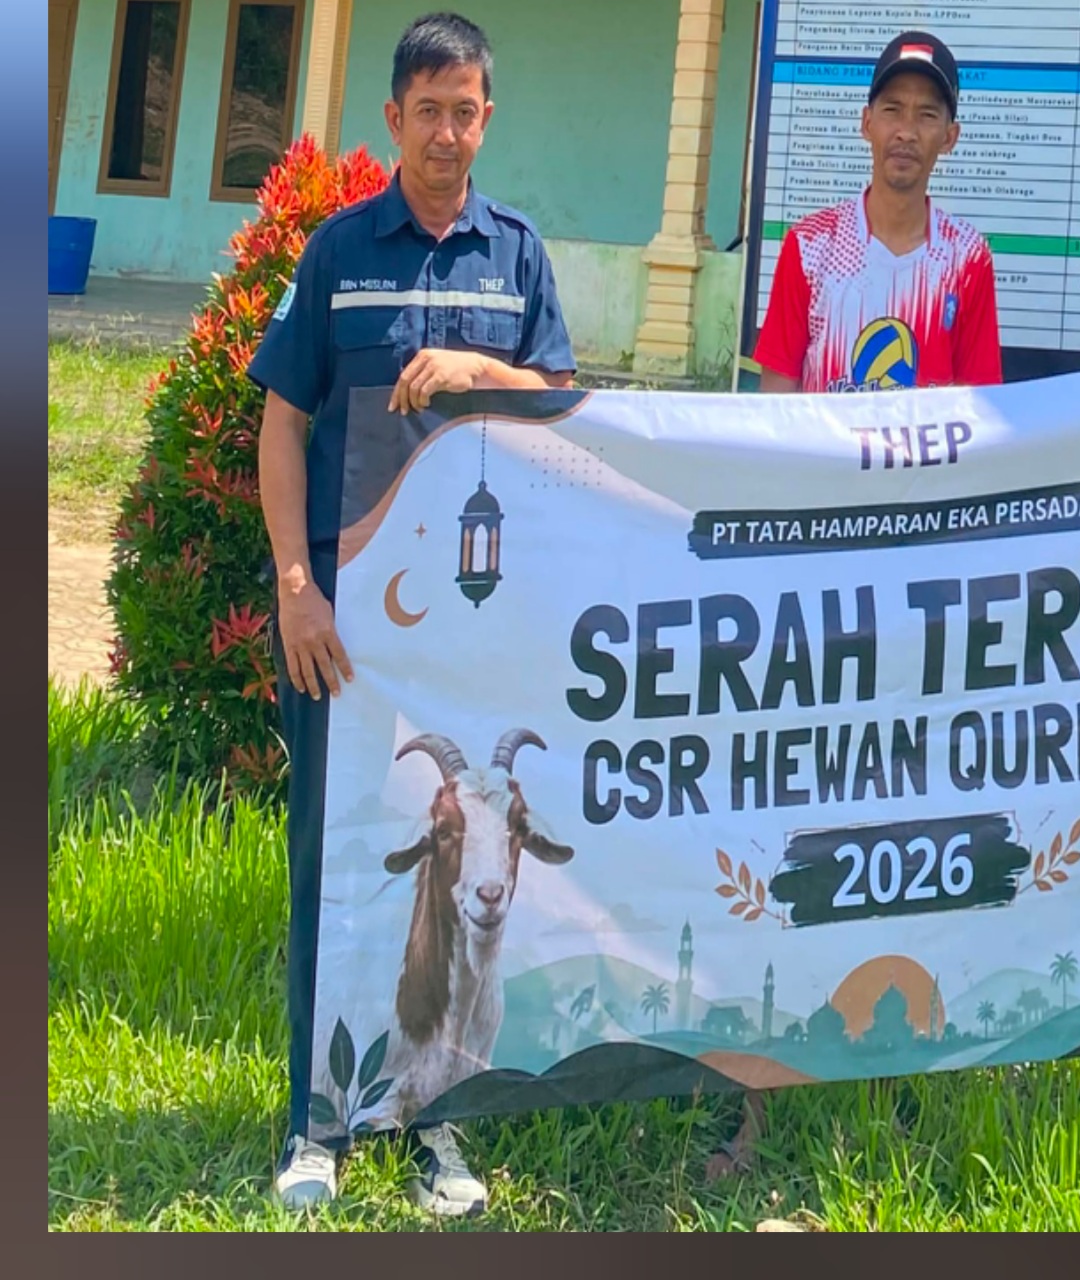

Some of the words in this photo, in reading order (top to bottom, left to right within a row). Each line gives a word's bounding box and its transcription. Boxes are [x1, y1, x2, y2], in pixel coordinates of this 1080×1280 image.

[478, 278, 504, 291] THEP
[850, 420, 973, 471] THEP
[712, 522, 737, 546] PT
[746, 520, 803, 544] TATA
[809, 511, 942, 539] HAMPARAN
[947, 504, 990, 529] EKA
[565, 585, 877, 723] SERAH
[582, 730, 710, 825] CSR
[730, 715, 929, 812] HEWAN
[831, 833, 974, 909] 2026
